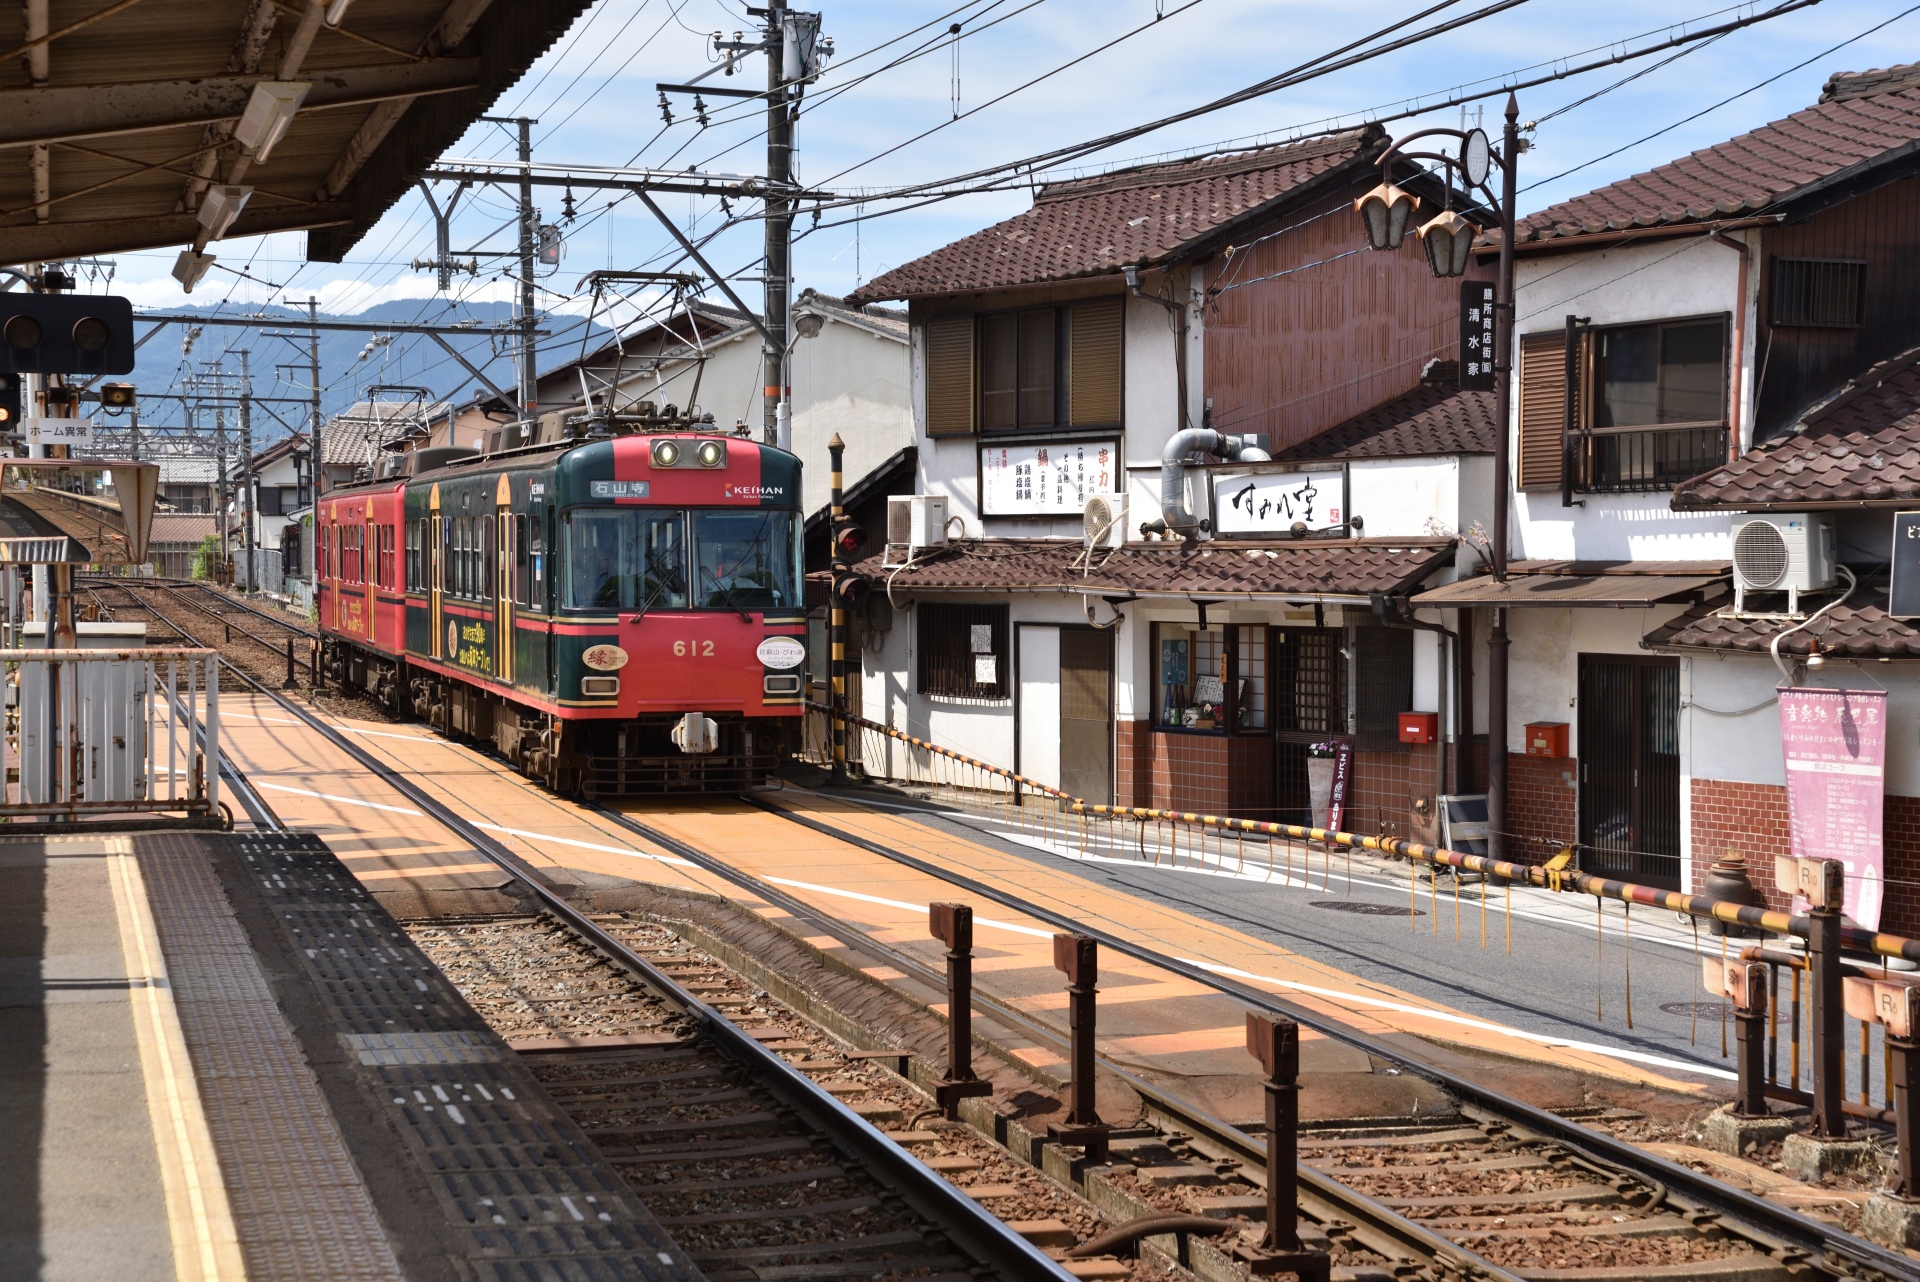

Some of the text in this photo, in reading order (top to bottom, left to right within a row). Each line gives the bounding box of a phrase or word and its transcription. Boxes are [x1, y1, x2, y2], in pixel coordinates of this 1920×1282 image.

[1468, 308, 1480, 376] 清水家
[30, 426, 87, 437] ホーム異常
[1002, 449, 1008, 468] 電話
[1037, 448, 1049, 467] 鍋
[1098, 448, 1109, 493] 串カ
[595, 482, 645, 494] 石山寺
[734, 486, 783, 494] KEIHAN
[1232, 476, 1318, 522] すみれ堂
[587, 650, 608, 666] 縁
[673, 640, 715, 657] 612
[1785, 703, 1878, 726] 音楽処 辰巳屋
[1330, 802, 1340, 831] ありま
[1801, 867, 1818, 886] R10
